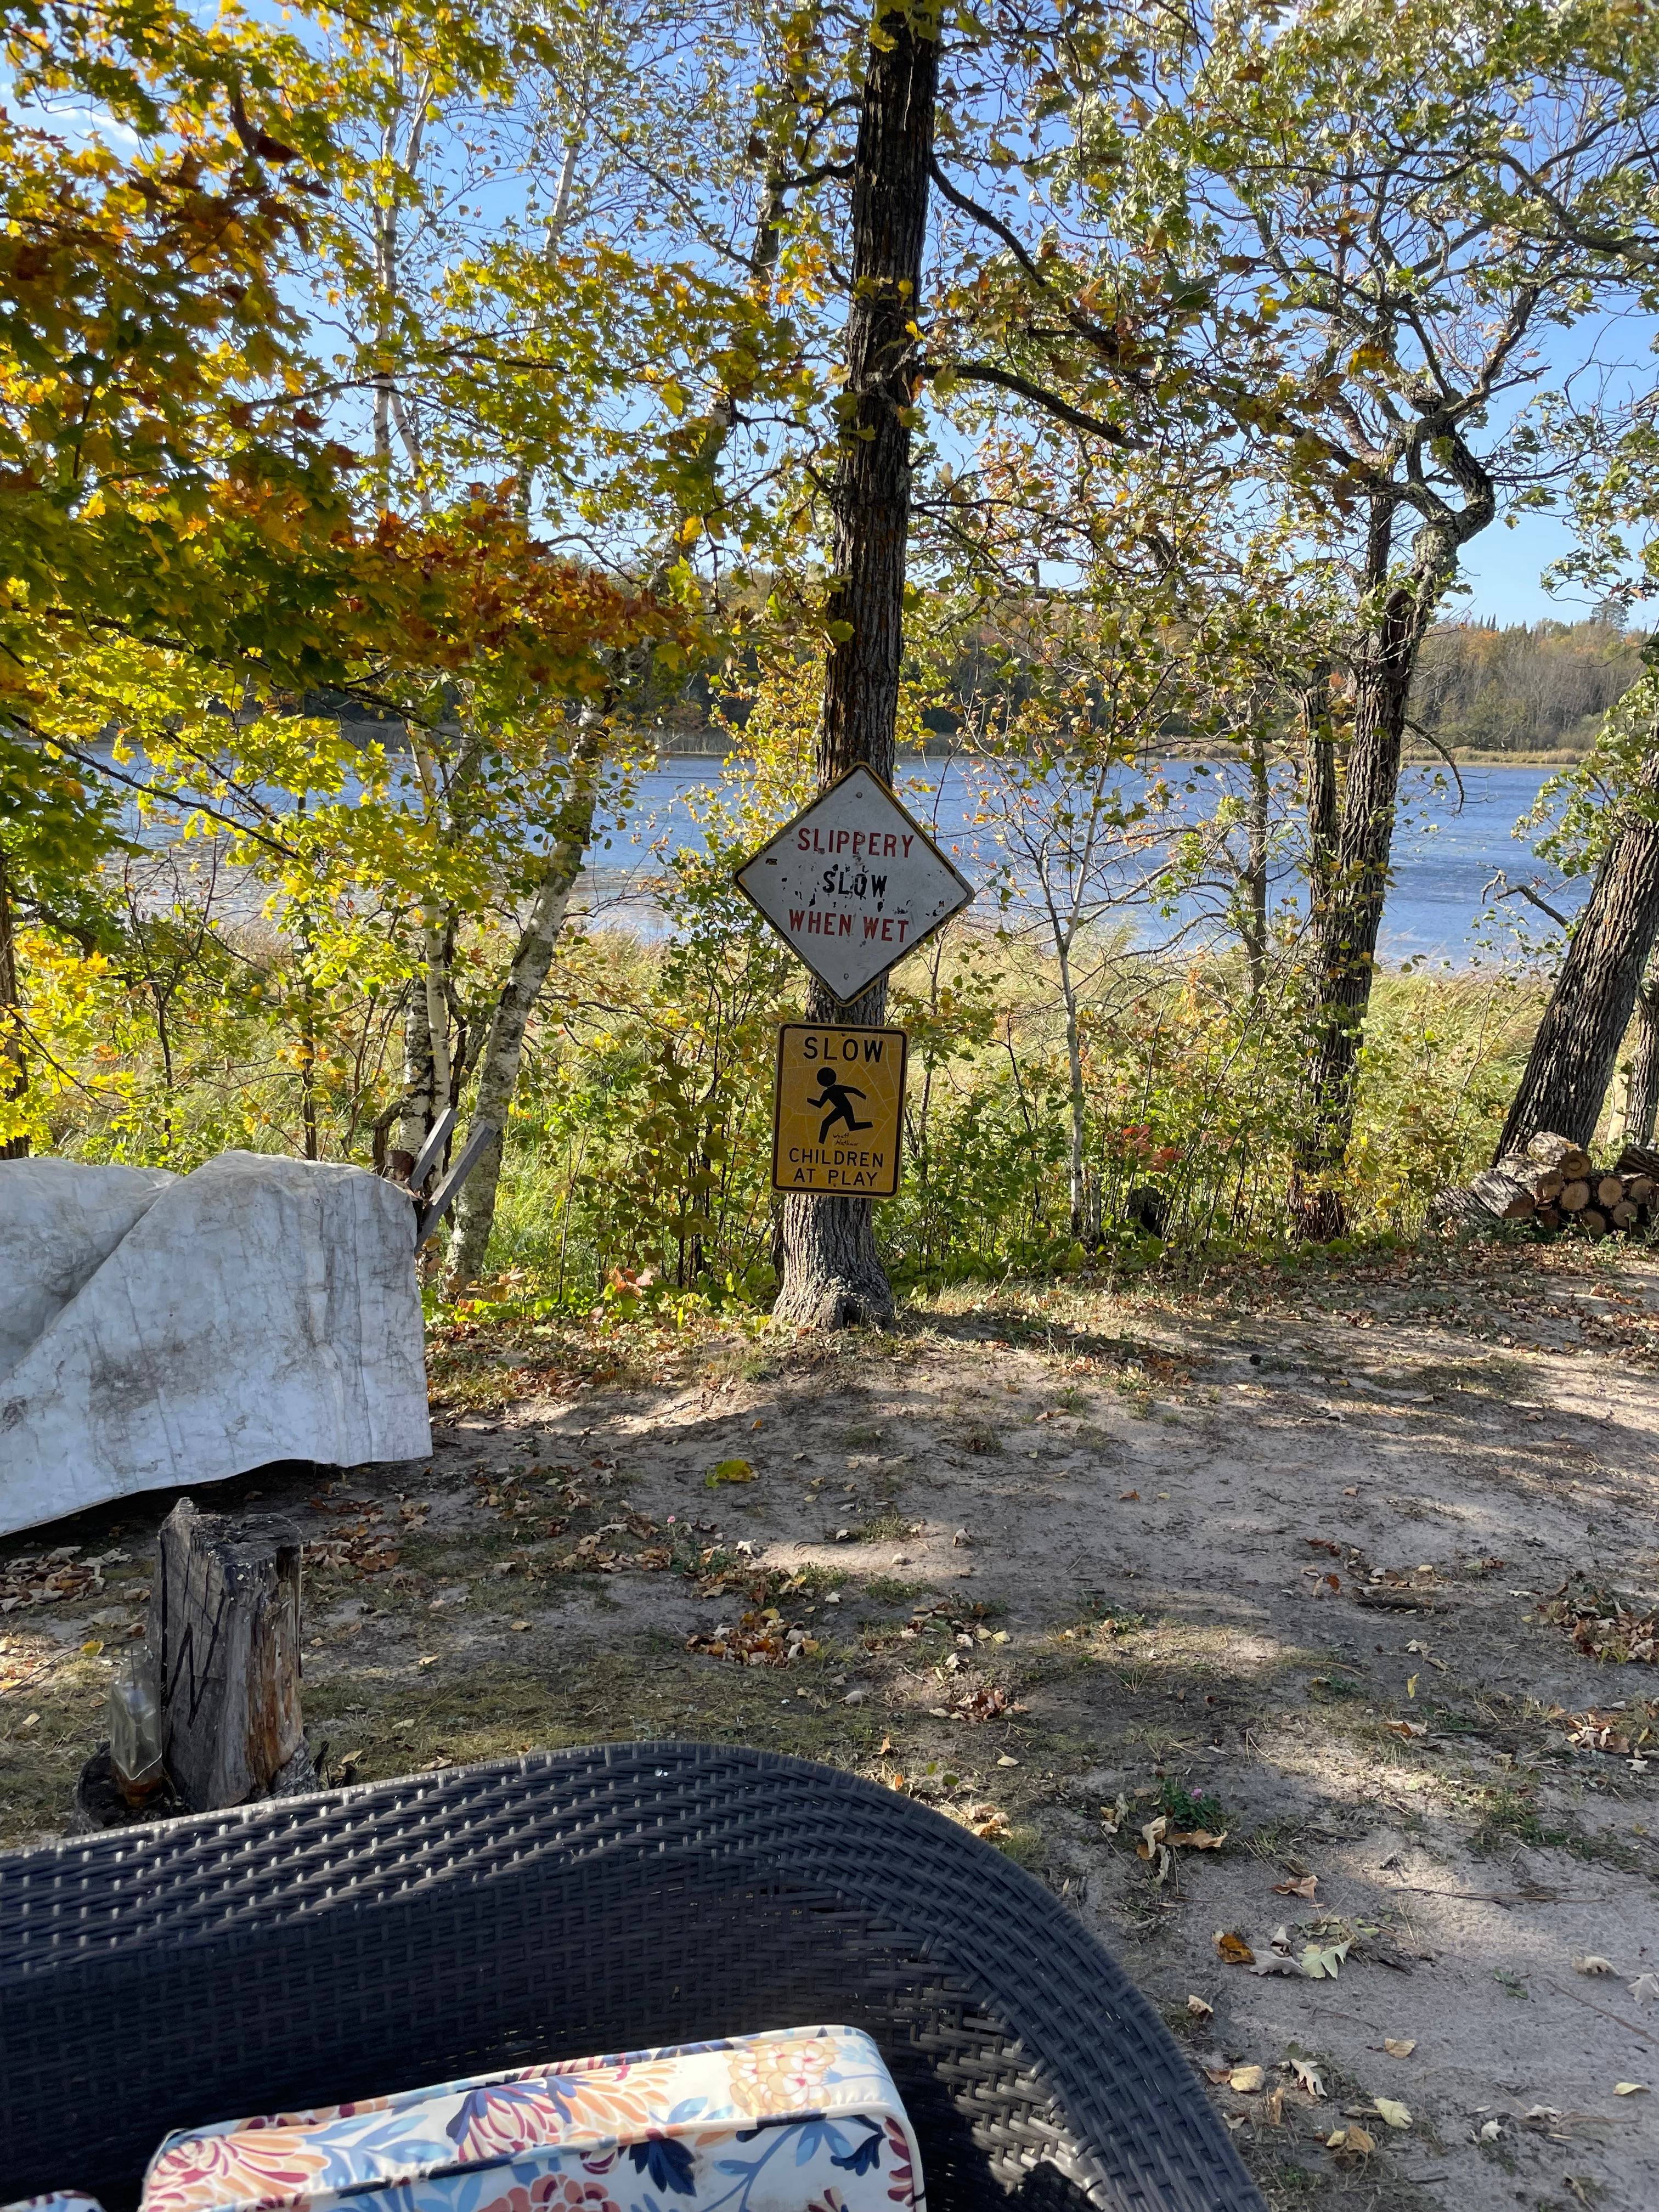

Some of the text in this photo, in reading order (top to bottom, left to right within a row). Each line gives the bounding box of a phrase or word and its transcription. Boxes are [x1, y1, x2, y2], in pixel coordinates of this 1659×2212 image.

[797, 827, 915, 858] SLIPPERY
[822, 870, 888, 898] SLOW
[789, 909, 909, 943] WHEN WET
[803, 1036, 883, 1063] SLOW
[789, 1147, 883, 1168] CHILDREN
[793, 1167, 878, 1187] AT PLAY
